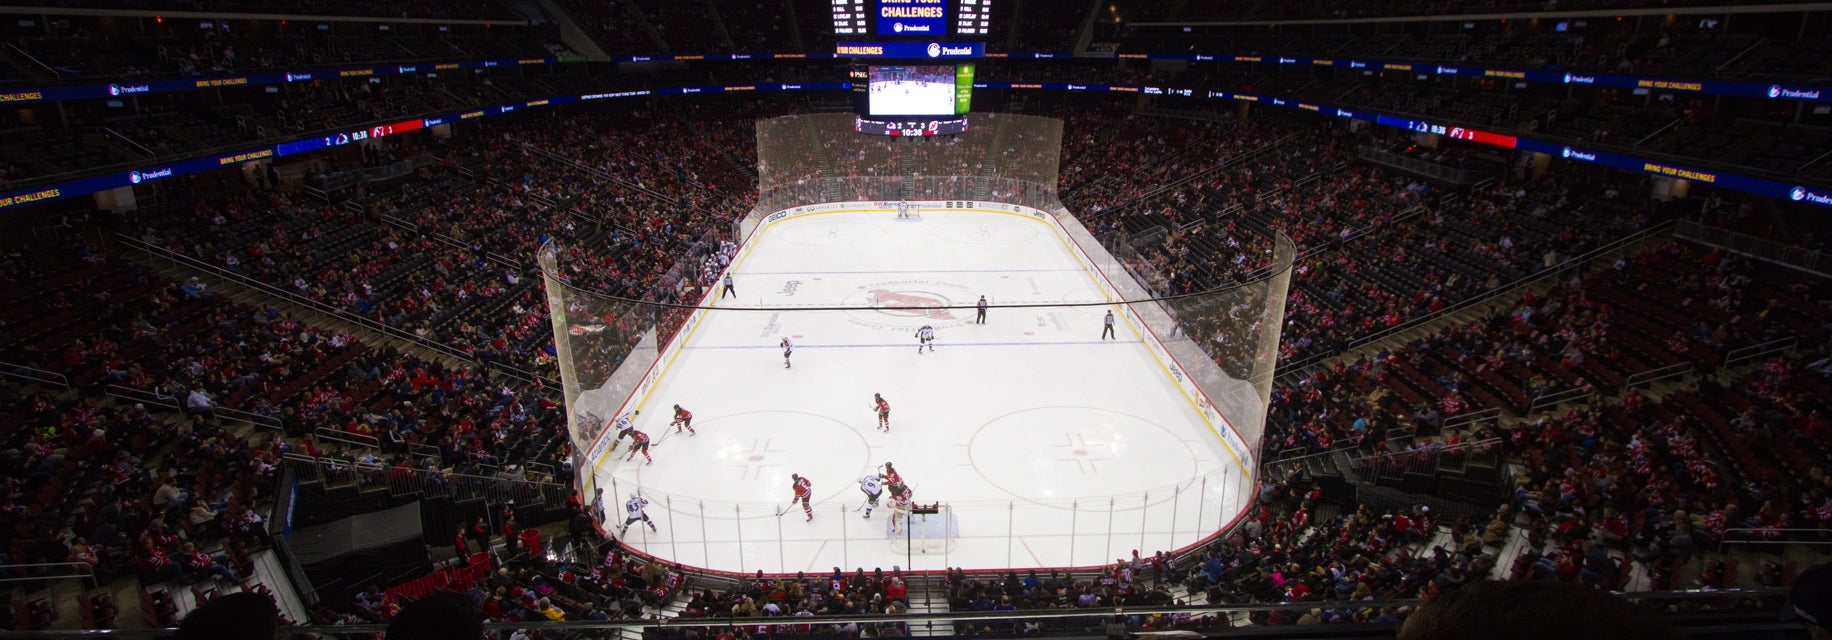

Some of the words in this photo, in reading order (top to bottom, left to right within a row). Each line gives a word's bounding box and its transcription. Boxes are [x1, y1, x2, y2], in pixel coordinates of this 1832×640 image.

[881, 7, 943, 17] CHALLENGES
[942, 47, 971, 55] Prudential
[121, 85, 149, 94] Prudential
[1781, 89, 1820, 98] Prudential
[325, 137, 331, 146] 2
[352, 131, 368, 141] 10:36
[1571, 151, 1595, 161] Prudential
[142, 168, 171, 180] Prudential
[1644, 163, 1661, 173] BRING
[1662, 167, 1677, 175] YOUR
[1678, 170, 1715, 183] CHALLENGES
[15, 189, 60, 204] CHALLENGES
[769, 211, 787, 222] GEICO
[776, 280, 803, 296] Jeep
[1169, 360, 1183, 382] Jeep
[591, 432, 611, 460] Atlantic
